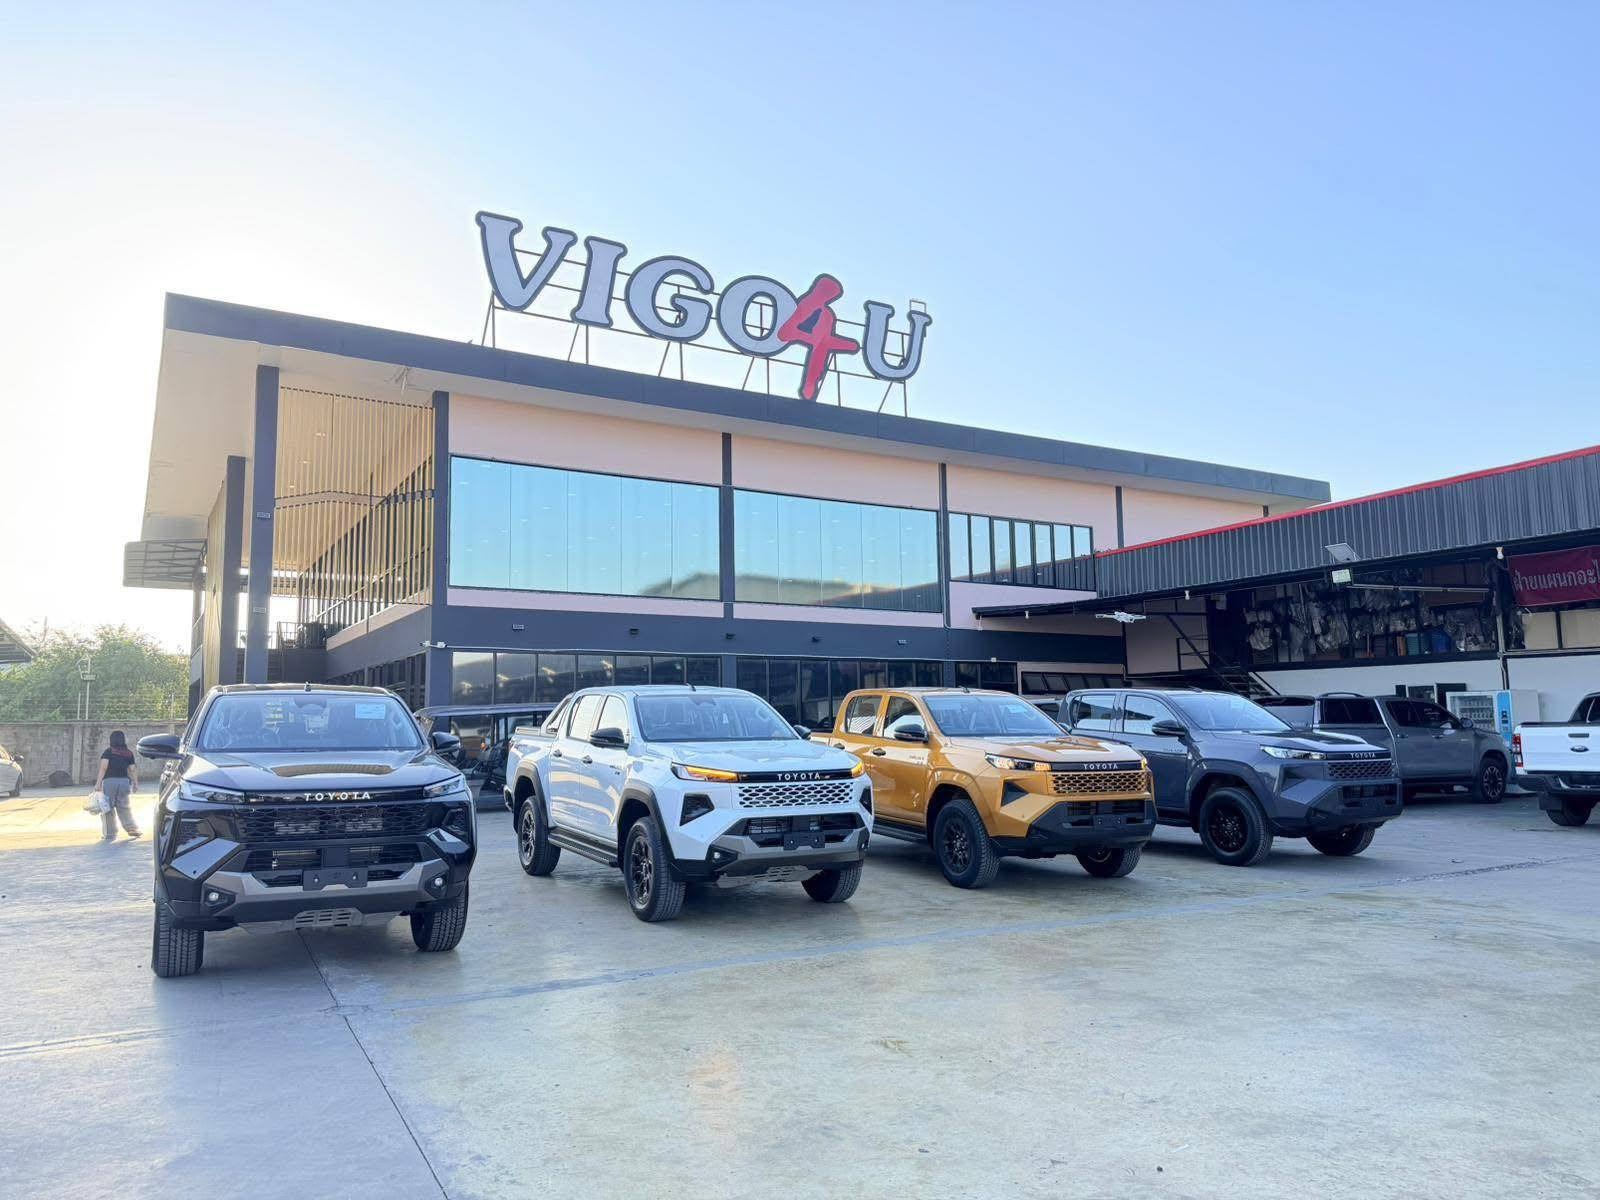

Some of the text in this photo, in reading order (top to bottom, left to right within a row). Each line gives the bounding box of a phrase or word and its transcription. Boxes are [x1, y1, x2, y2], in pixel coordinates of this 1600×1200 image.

[475, 211, 932, 401] VIGO4U
[777, 772, 820, 781] TOYOTA
[304, 791, 370, 802] TOYOTA
